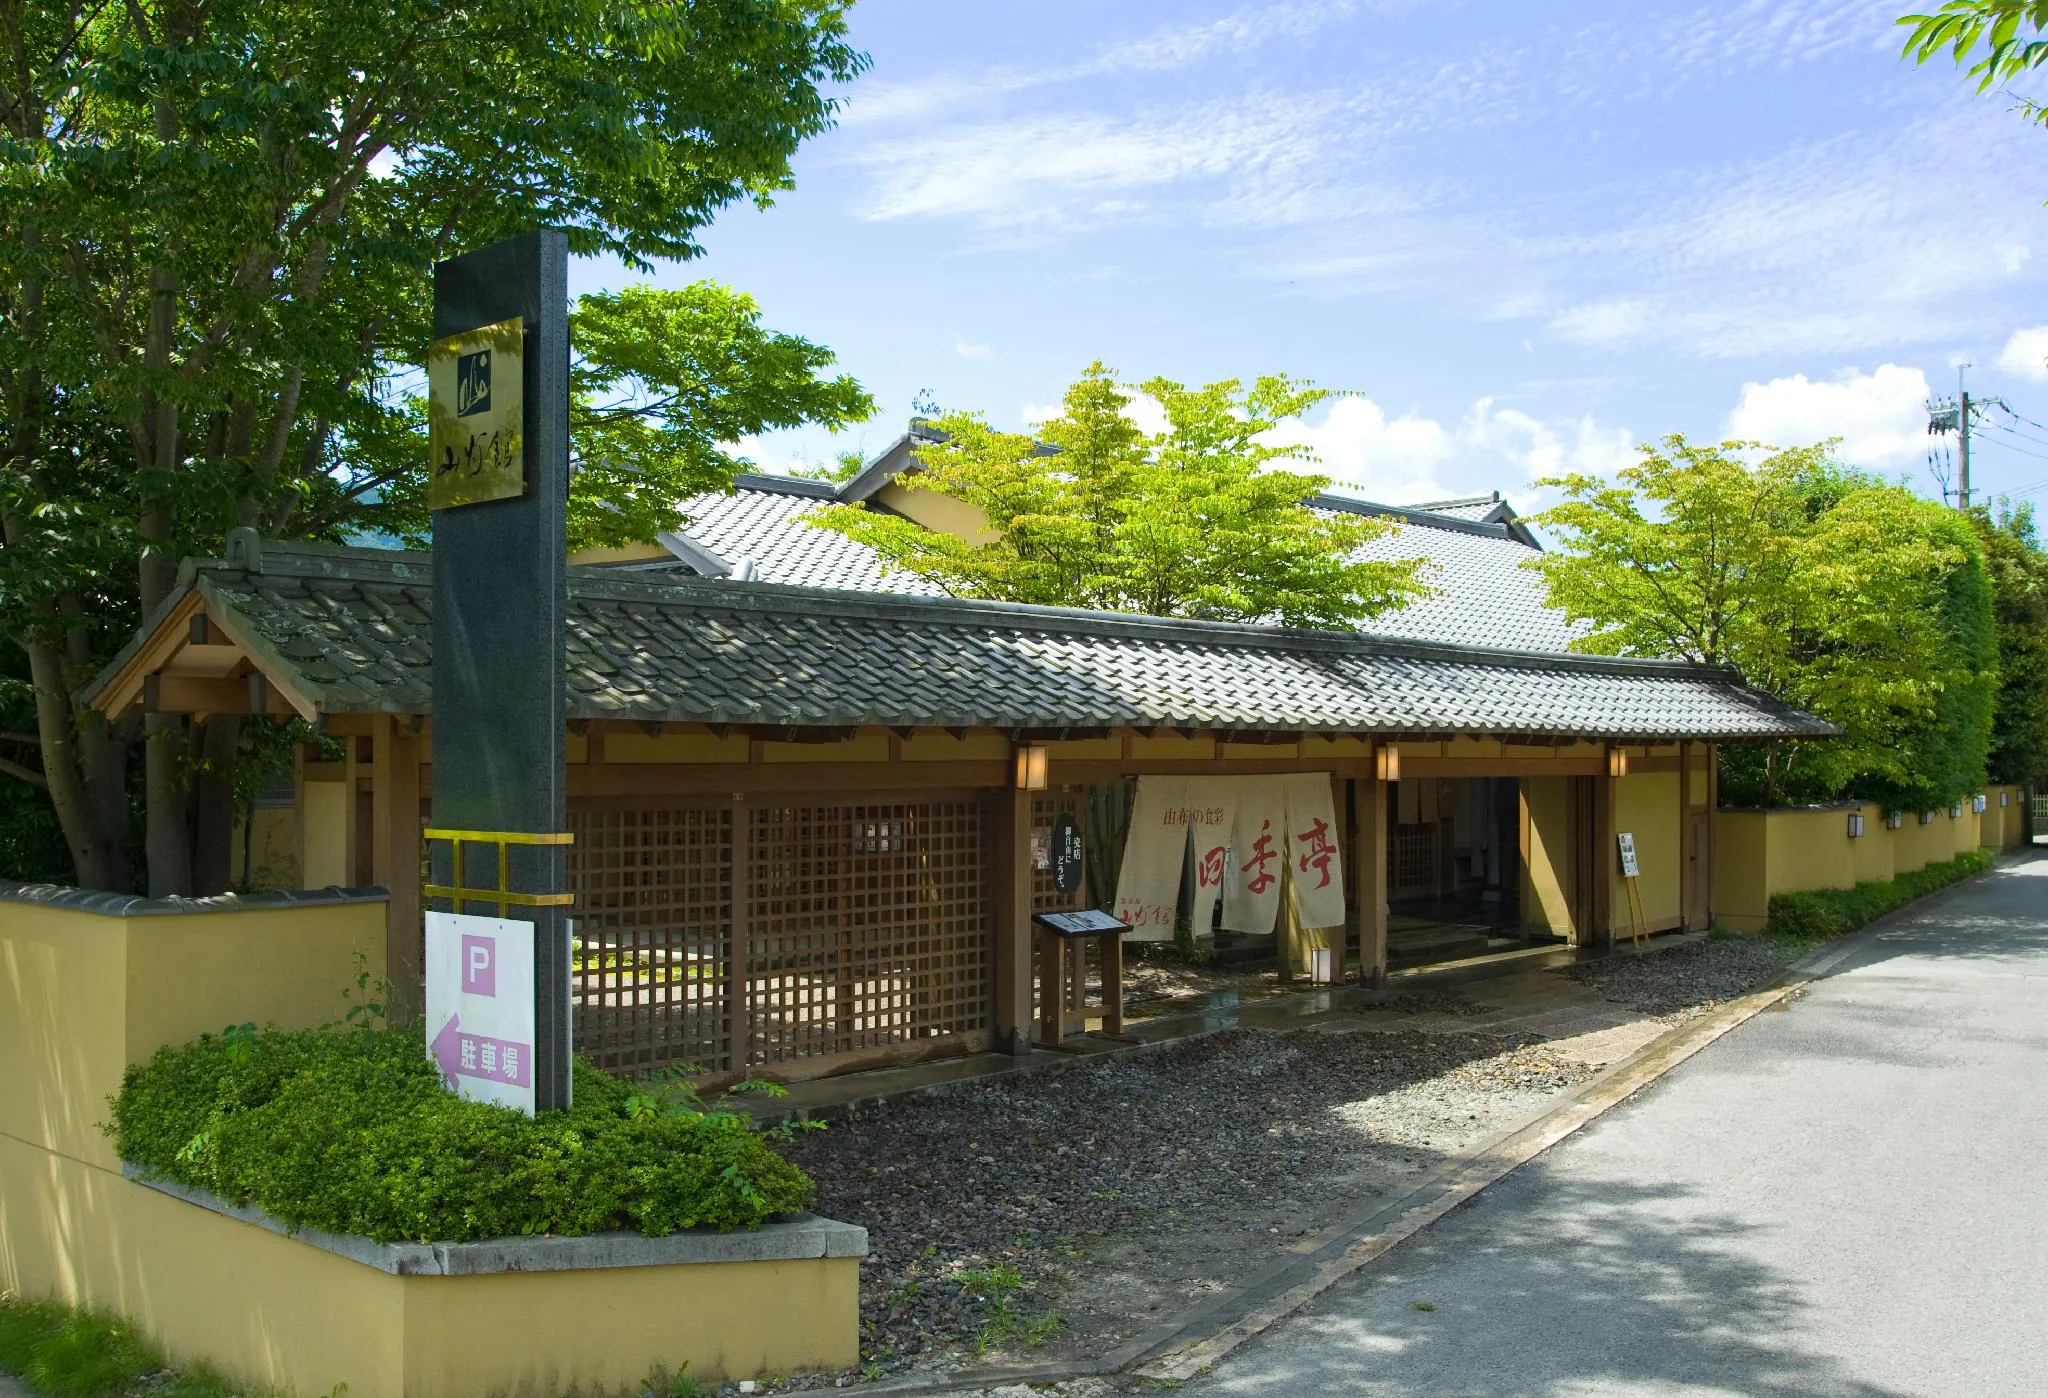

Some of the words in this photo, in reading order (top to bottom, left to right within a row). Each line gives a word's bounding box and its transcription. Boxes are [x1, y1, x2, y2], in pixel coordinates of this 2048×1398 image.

[469, 945, 490, 983] P
[461, 1039, 519, 1079] 駐車場
